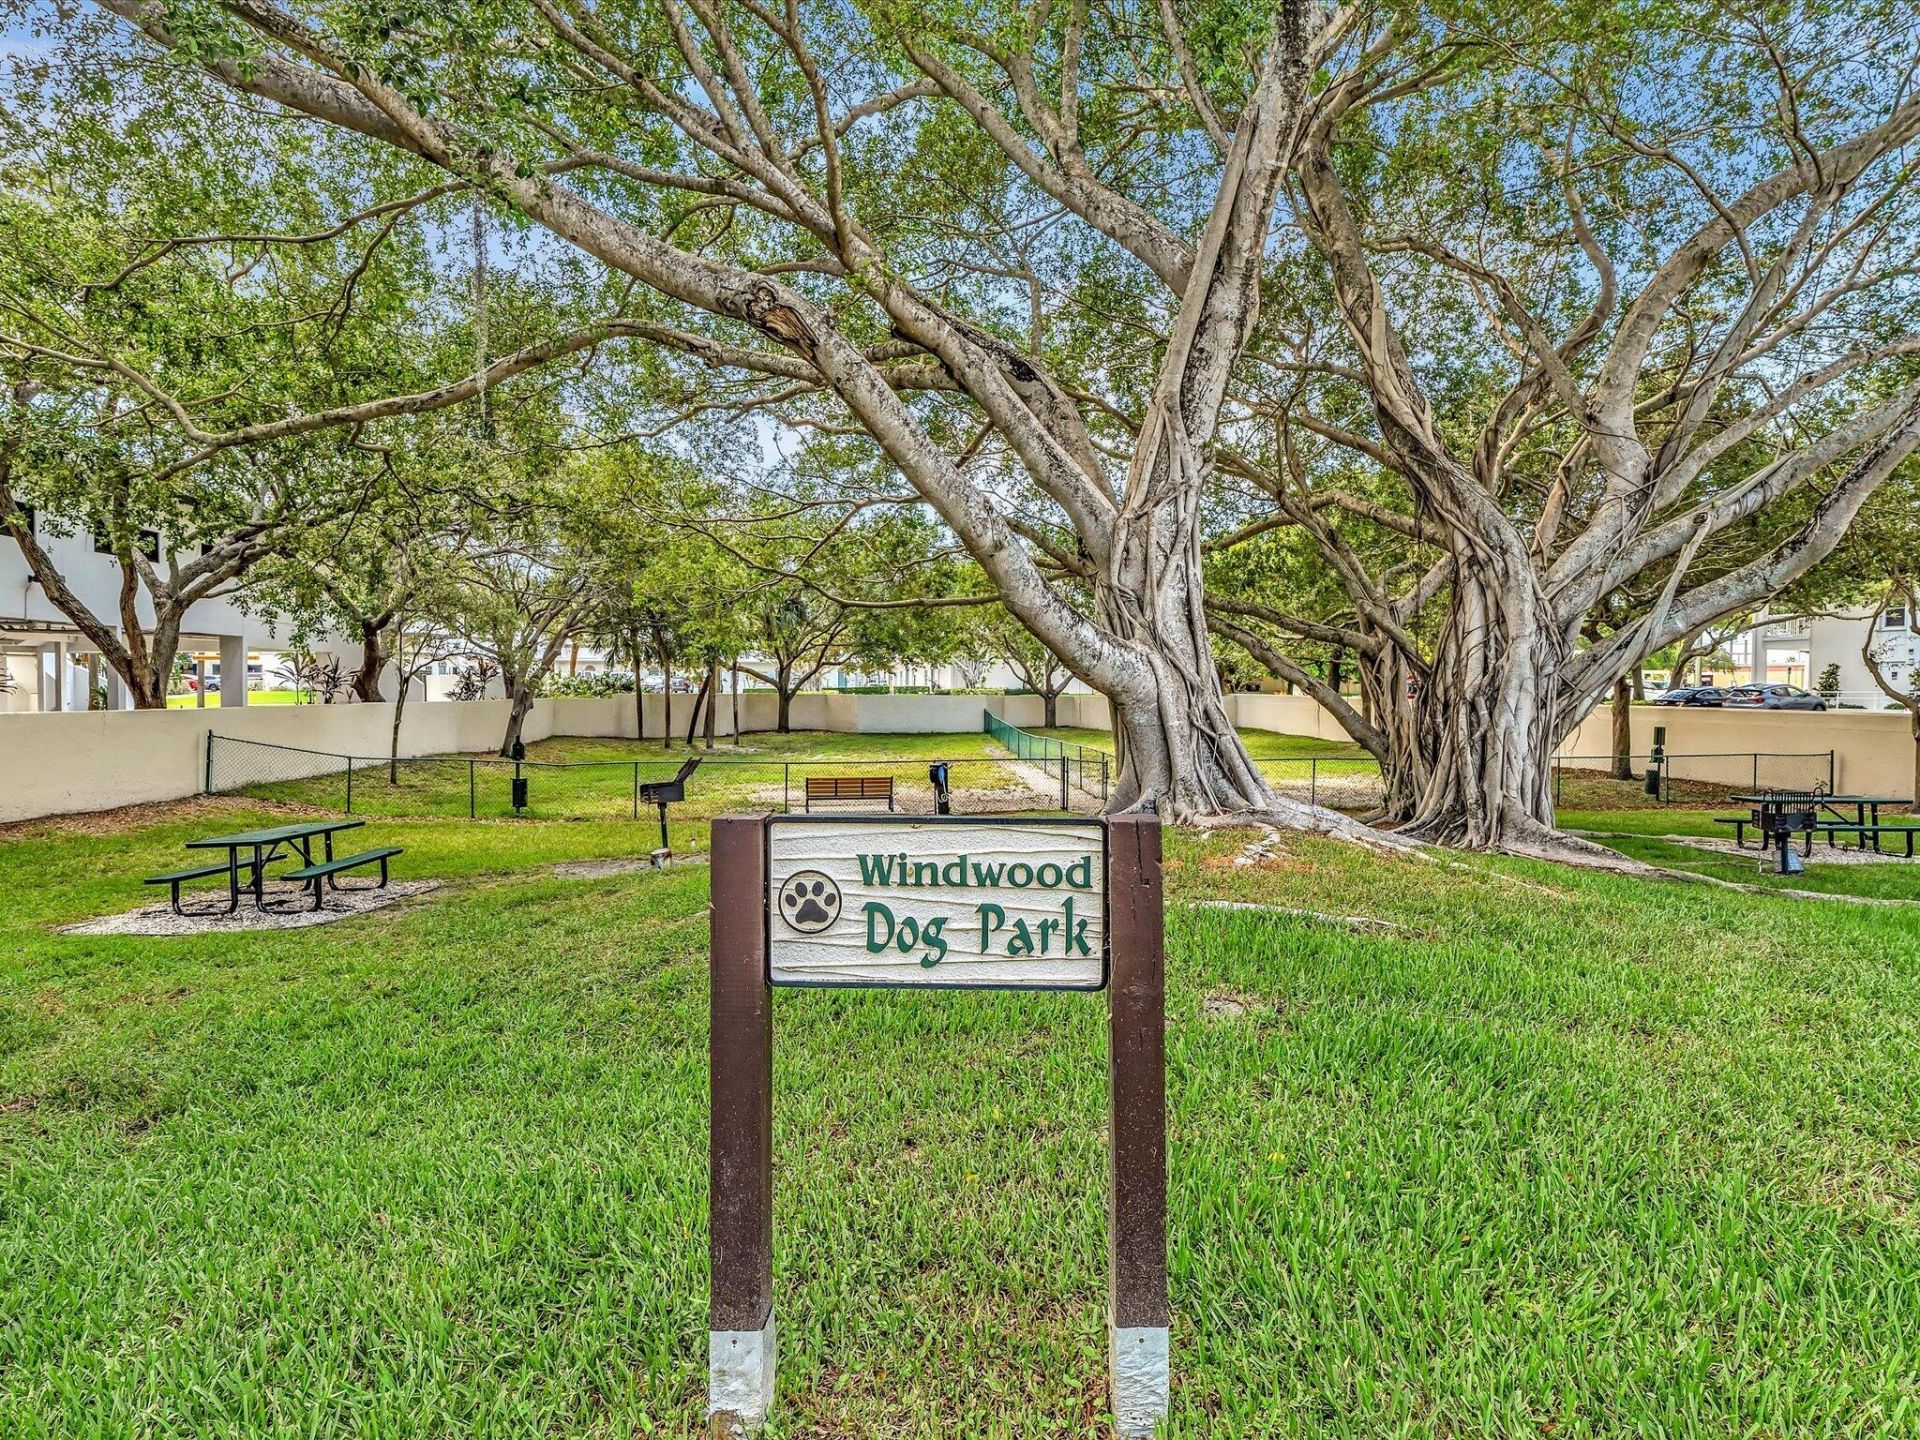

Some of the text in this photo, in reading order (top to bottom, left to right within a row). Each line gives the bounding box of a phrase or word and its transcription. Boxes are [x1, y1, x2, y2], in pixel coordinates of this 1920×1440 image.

[857, 852, 1093, 889] Windwood
[861, 896, 1093, 969] Dog Park
